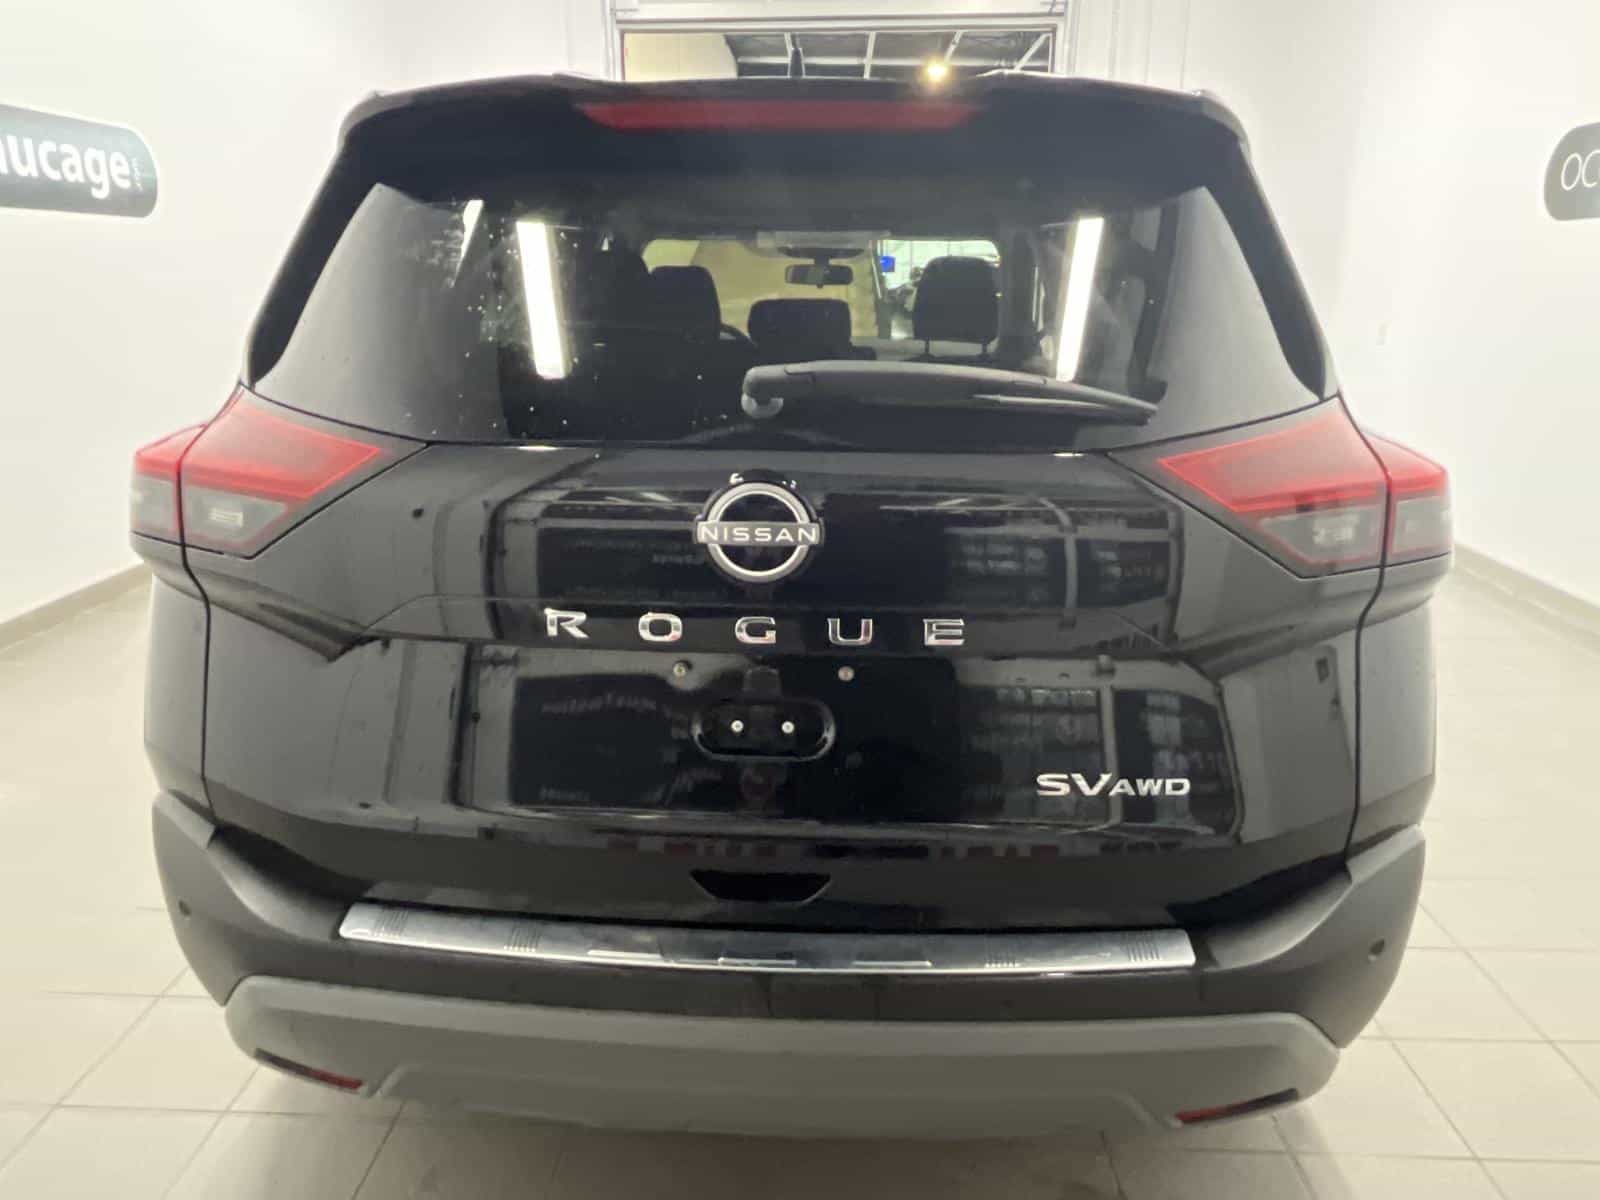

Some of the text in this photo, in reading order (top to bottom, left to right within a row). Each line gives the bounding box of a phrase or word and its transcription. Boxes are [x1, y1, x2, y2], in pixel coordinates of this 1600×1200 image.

[0, 134, 131, 199] ucage
[699, 525, 818, 544] NISSAN
[544, 607, 965, 647] ROGUE
